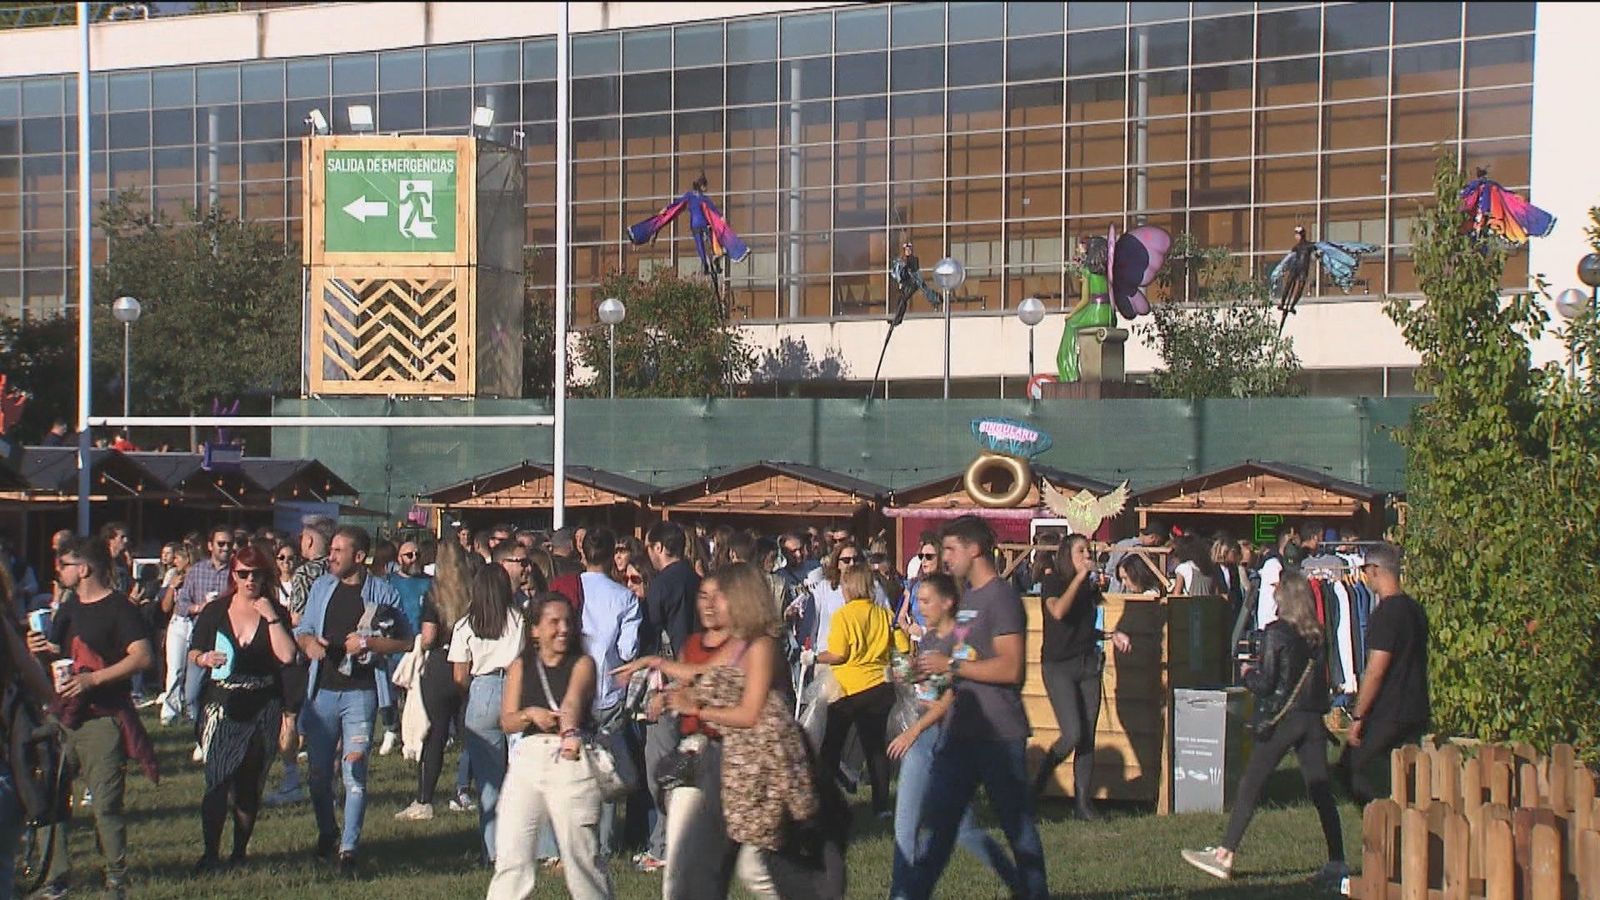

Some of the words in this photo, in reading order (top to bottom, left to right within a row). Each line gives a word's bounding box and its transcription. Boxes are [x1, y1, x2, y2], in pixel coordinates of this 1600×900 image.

[328, 158, 365, 172] SALIDA
[367, 158, 380, 172] DE
[382, 159, 454, 173] EMERGENCIAS
